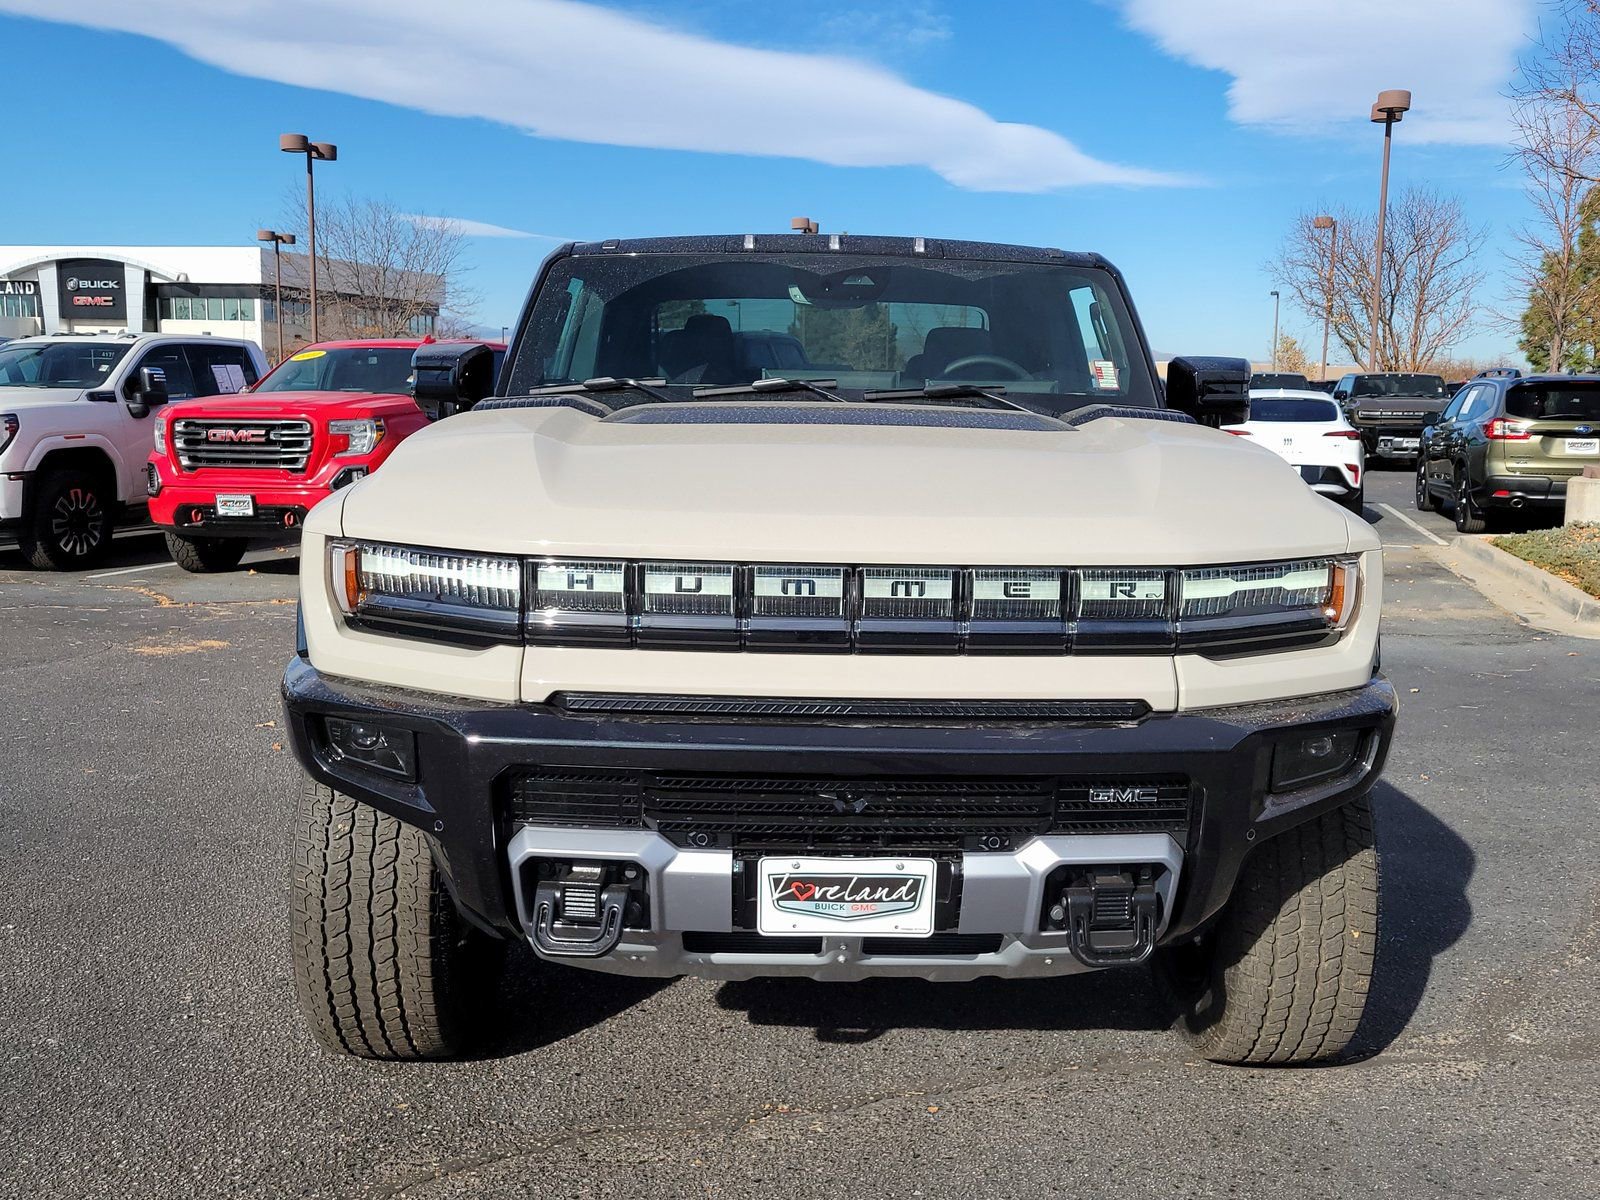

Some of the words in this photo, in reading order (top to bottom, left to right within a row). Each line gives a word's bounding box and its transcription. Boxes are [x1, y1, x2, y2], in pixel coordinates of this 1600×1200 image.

[79, 280, 119, 289] BUICK
[73, 296, 112, 305] GMC
[207, 429, 266, 442] GMC
[1089, 787, 1158, 803] GMC
[814, 903, 846, 911] BUICK
[850, 903, 878, 912] GMC
